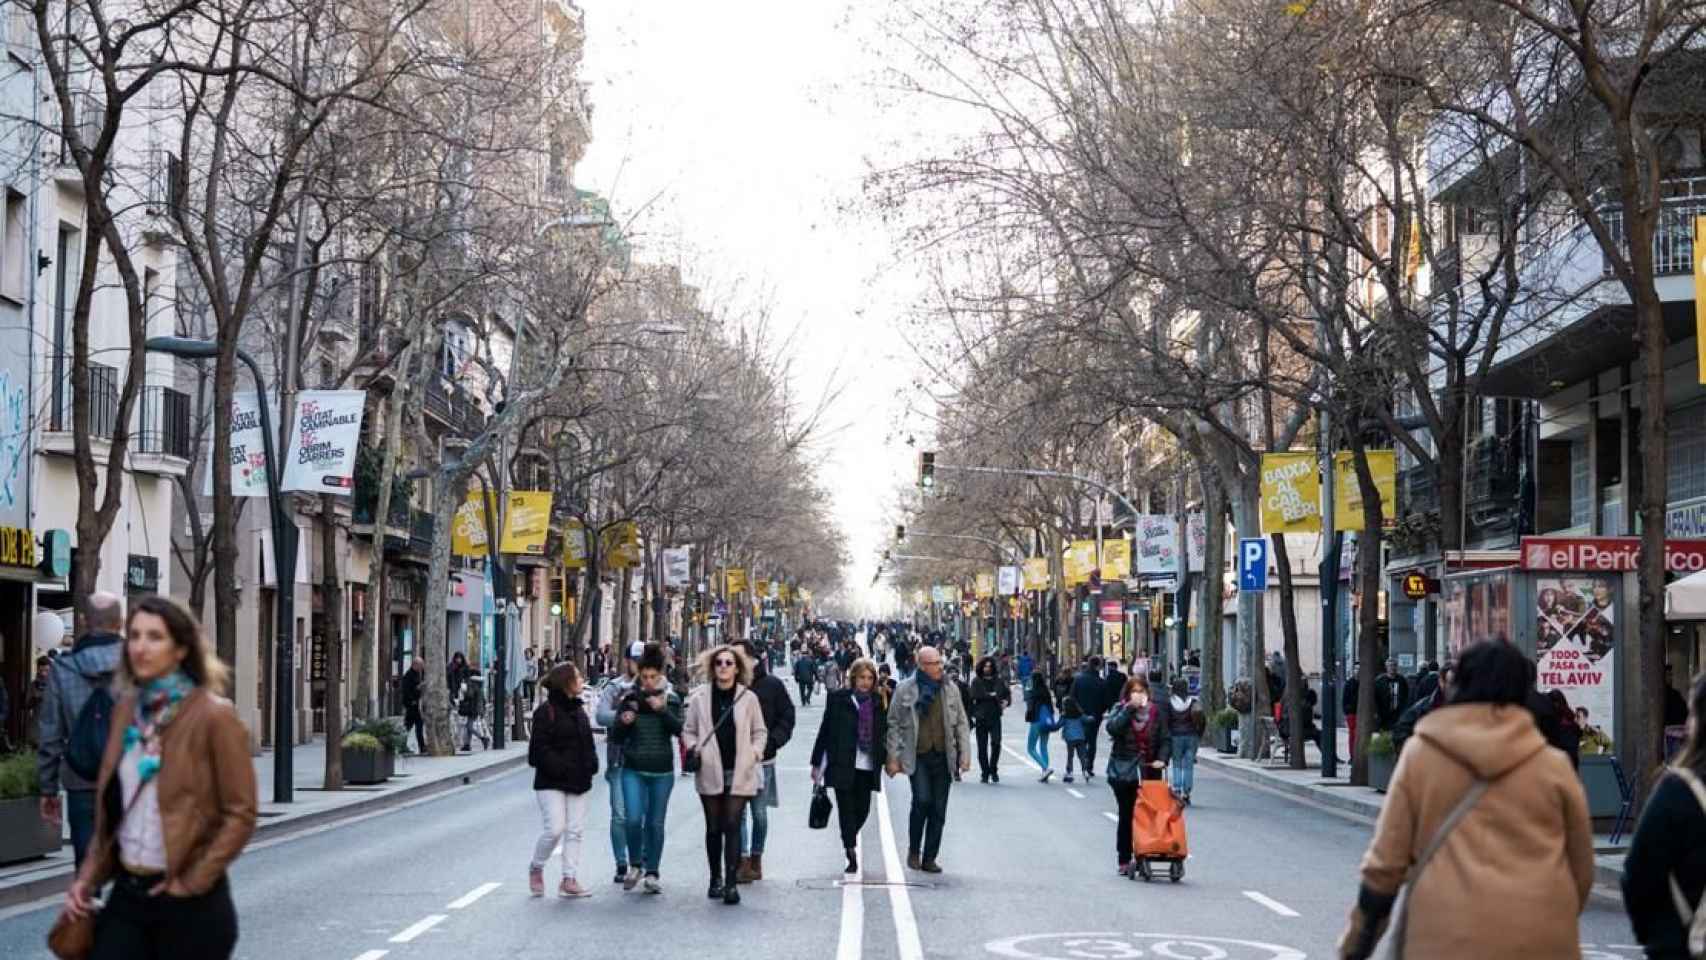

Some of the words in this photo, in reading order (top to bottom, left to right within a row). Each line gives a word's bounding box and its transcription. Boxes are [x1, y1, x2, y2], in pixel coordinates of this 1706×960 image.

[1264, 462, 1311, 485] BAIXA
[1278, 479, 1293, 495] AL
[1268, 490, 1301, 510] CAR
[1245, 542, 1262, 571] P
[1552, 544, 1574, 569] el
[1551, 651, 1580, 660] TODO
[1550, 661, 1575, 670] PASA
[1541, 672, 1564, 685] TEL
[1567, 672, 1602, 685] AVIV
